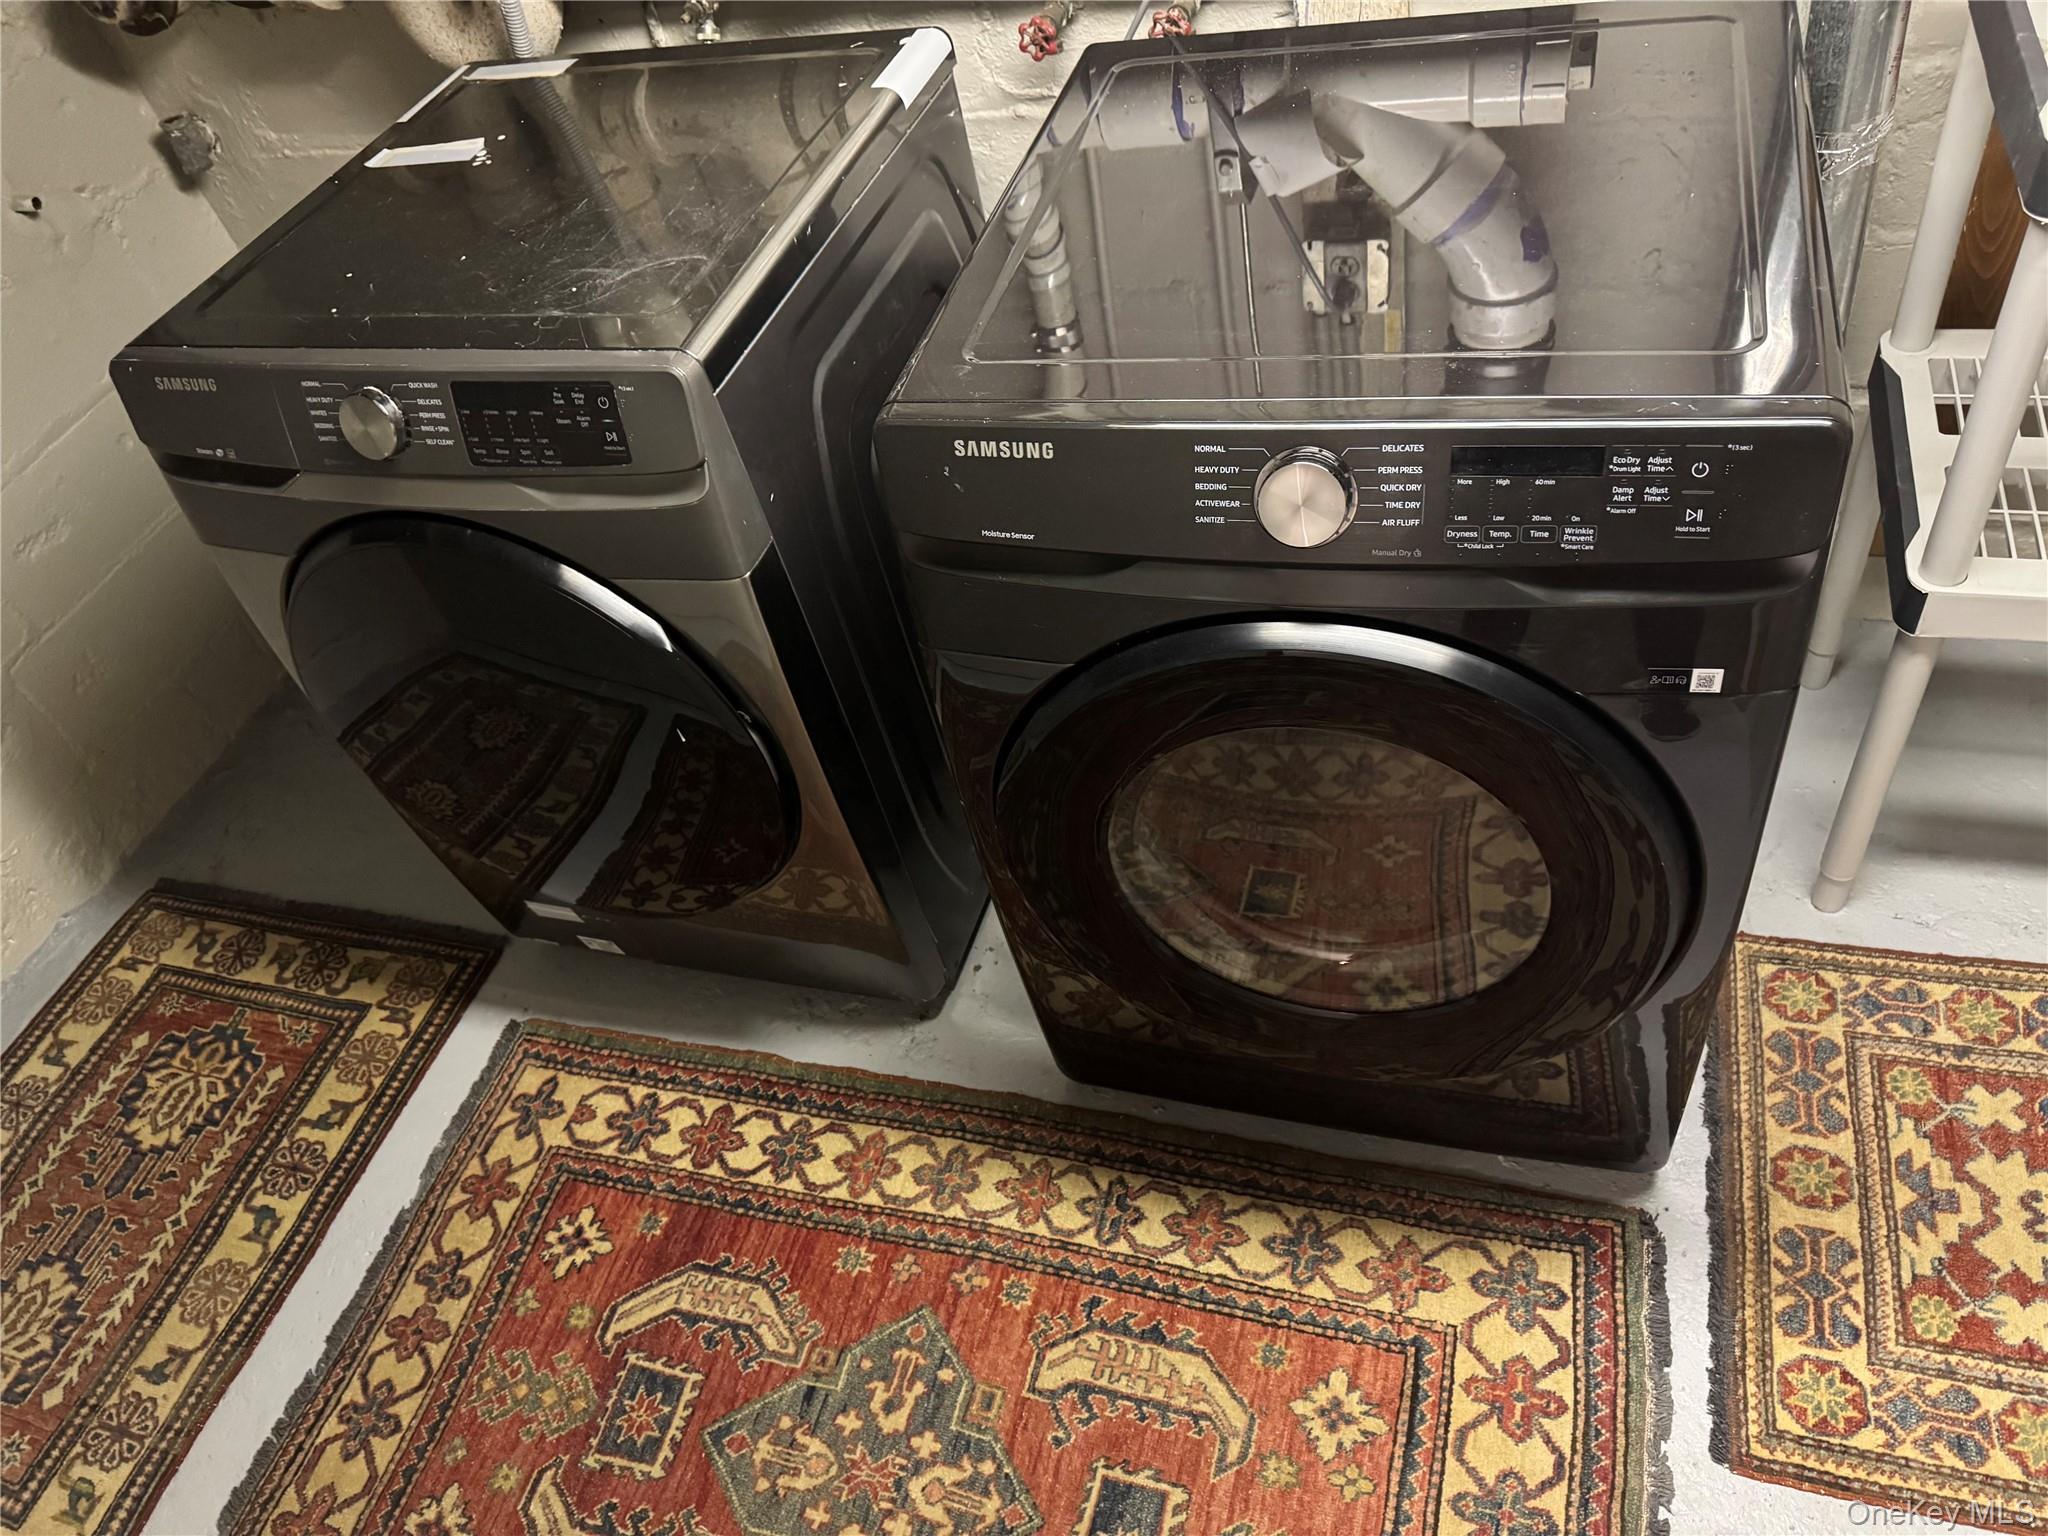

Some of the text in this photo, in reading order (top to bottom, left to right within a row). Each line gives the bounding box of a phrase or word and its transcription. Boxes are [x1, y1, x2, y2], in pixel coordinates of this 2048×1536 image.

[154, 376, 217, 392] SAMSUNG
[954, 439, 1054, 459] SAMSUNG
[1194, 445, 1226, 453] NORMAL
[1381, 444, 1425, 453] DELICATES
[1648, 457, 1673, 465] Adjust
[1194, 466, 1240, 474] HEAVY DUTY
[1378, 466, 1423, 474] PERM PRESS
[1195, 483, 1227, 491] BEDDING
[1380, 484, 1422, 492] QUICK DRY
[1612, 487, 1634, 495] Damp
[1644, 487, 1669, 495] Adjust
[1613, 494, 1632, 502] Alert
[1643, 494, 1662, 502] Time
[1195, 499, 1240, 508] ACTIVEWEAR
[1384, 501, 1421, 509] TIME DRY
[1195, 516, 1225, 524] SANITIZE
[1381, 519, 1420, 527] AIR FLUFF
[981, 529, 1035, 540] Moisture Sensor
[1446, 530, 1478, 539] Dryness
[1489, 530, 1512, 539] Temp.
[1530, 530, 1549, 538] Time
[1564, 527, 1594, 535] Wrinkle
[1563, 534, 1594, 542] Prevent
[1398, 549, 1411, 558] Dry
